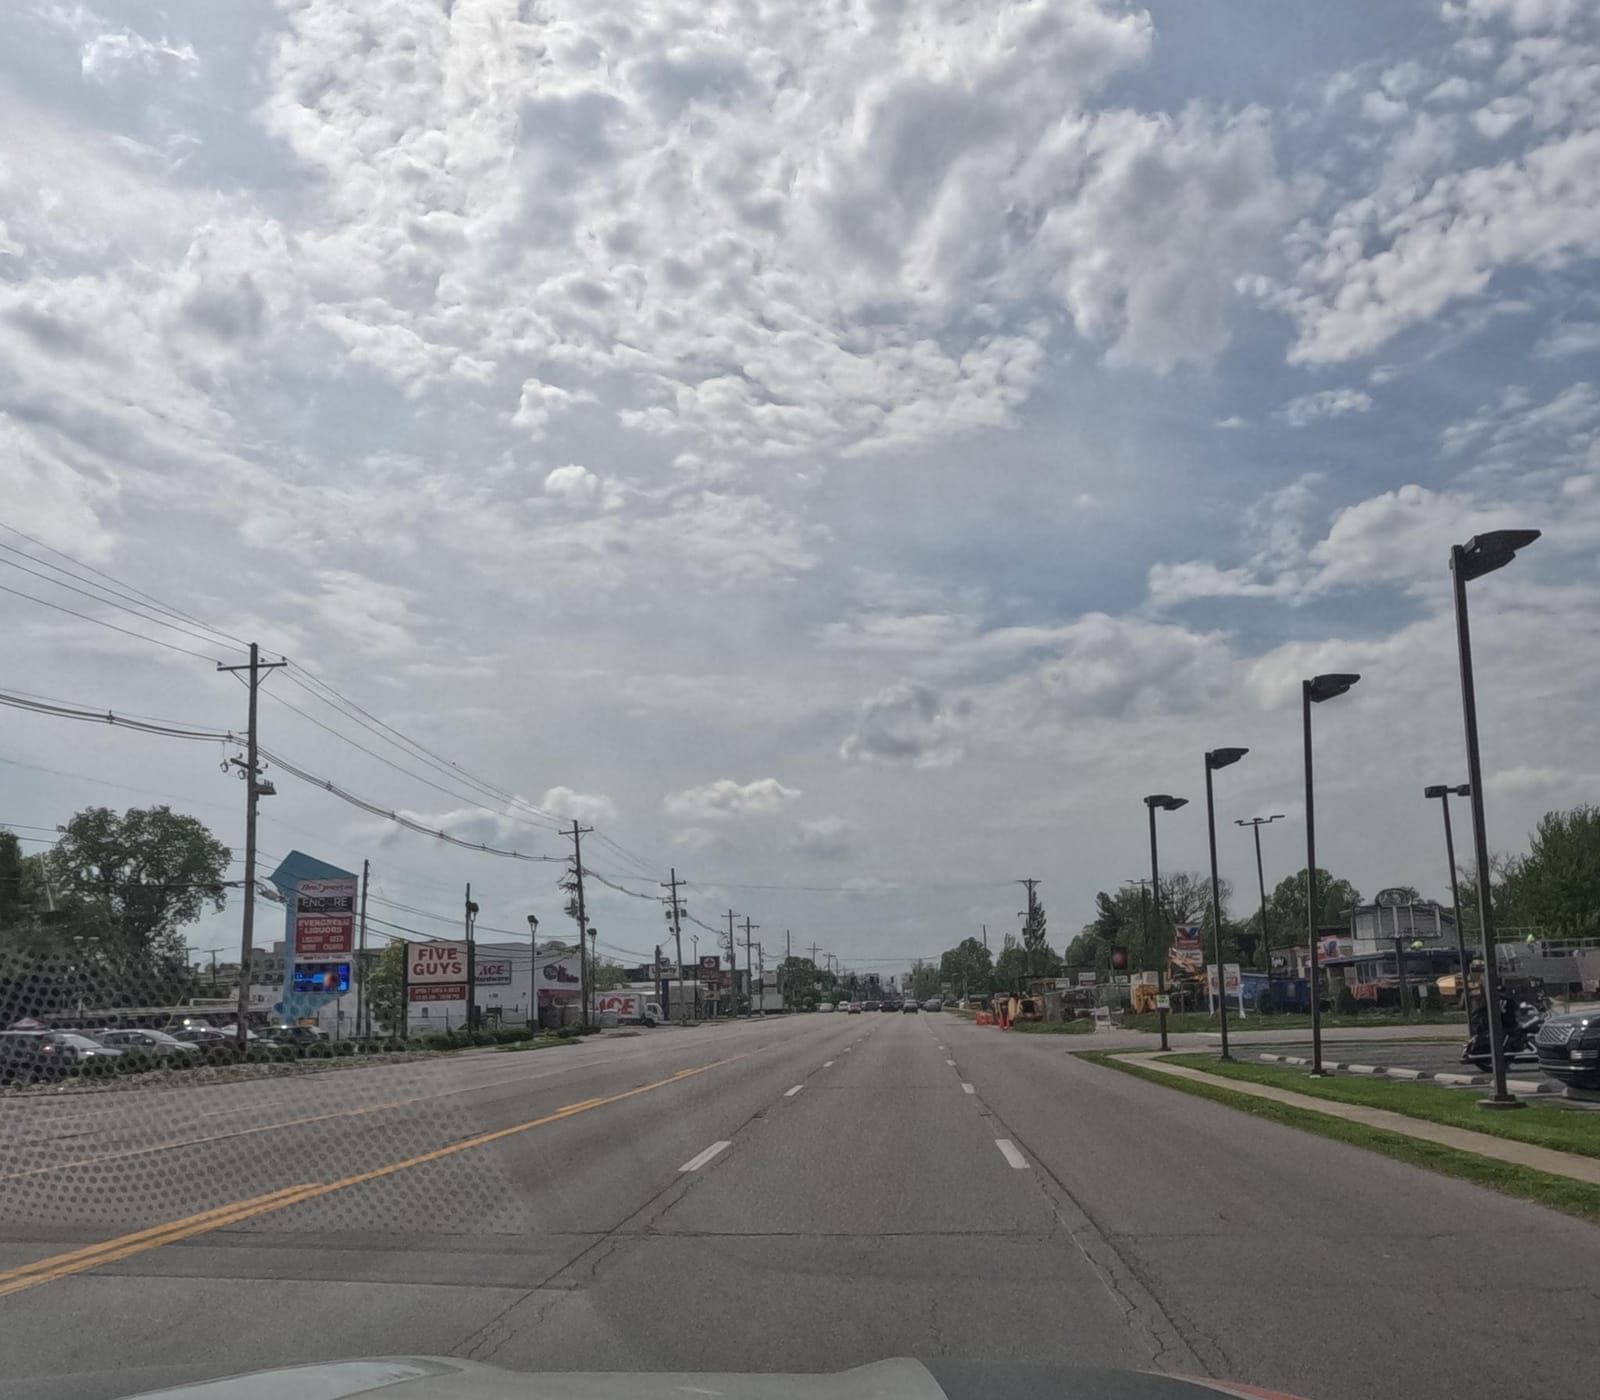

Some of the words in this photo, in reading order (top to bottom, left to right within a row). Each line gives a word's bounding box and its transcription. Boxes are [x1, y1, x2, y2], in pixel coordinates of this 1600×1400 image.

[419, 948, 457, 961] FIVE
[413, 962, 462, 976] GUYS
[479, 965, 505, 976] ACE
[597, 997, 635, 1015] ACE
